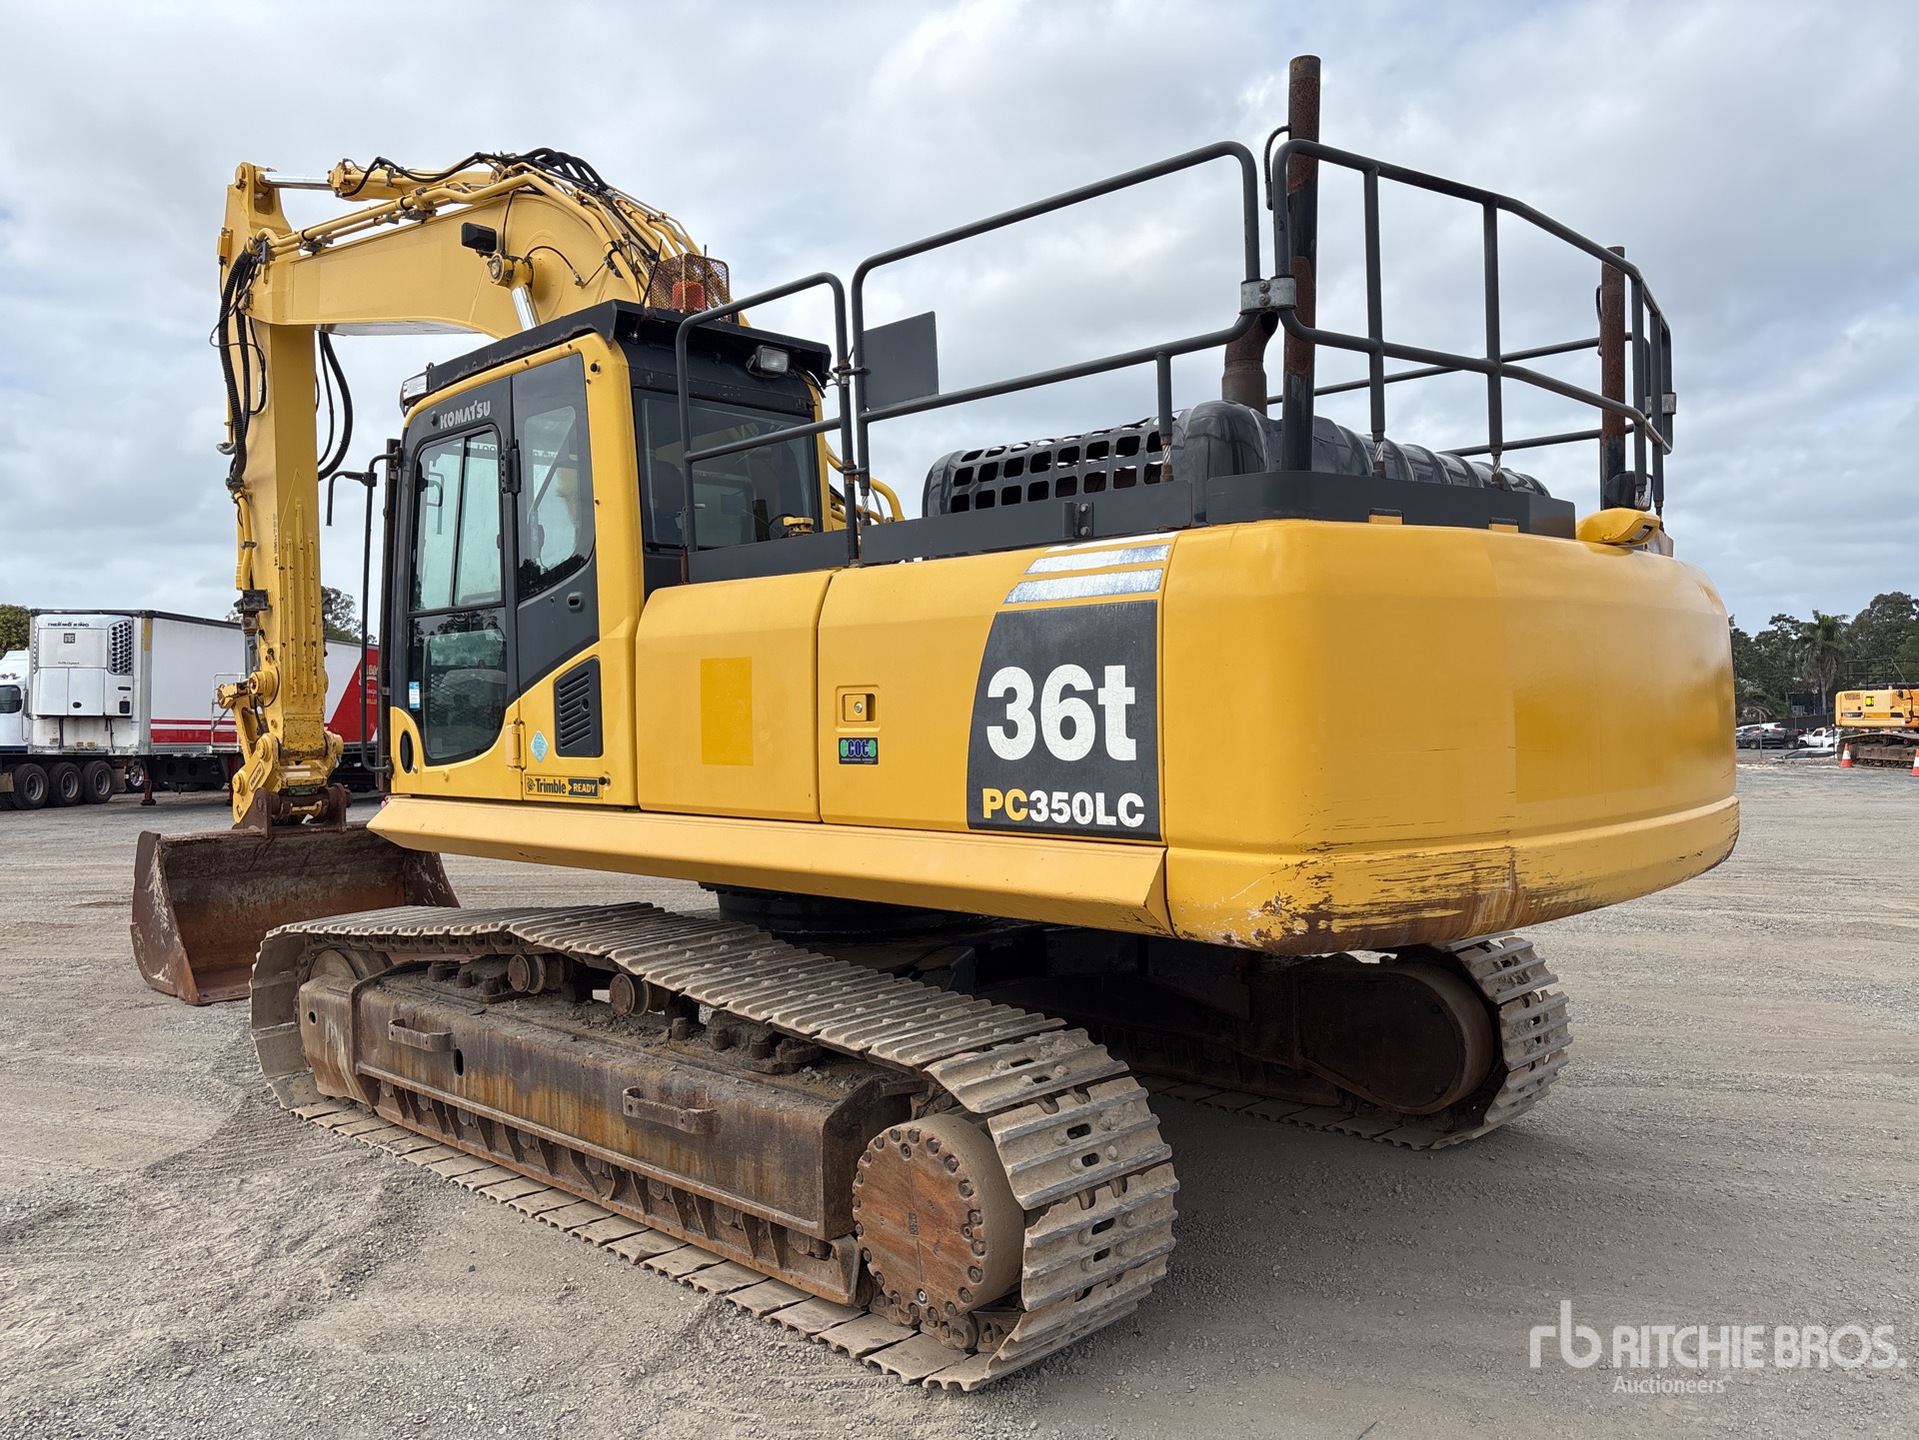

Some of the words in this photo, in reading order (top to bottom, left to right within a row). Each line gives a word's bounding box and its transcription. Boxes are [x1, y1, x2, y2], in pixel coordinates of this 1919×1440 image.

[440, 400, 490, 429] KOMATSU
[986, 664, 1137, 761] 36t
[535, 778, 567, 794] Trimble
[573, 783, 596, 793] READY
[982, 788, 1145, 828] PC350LC
